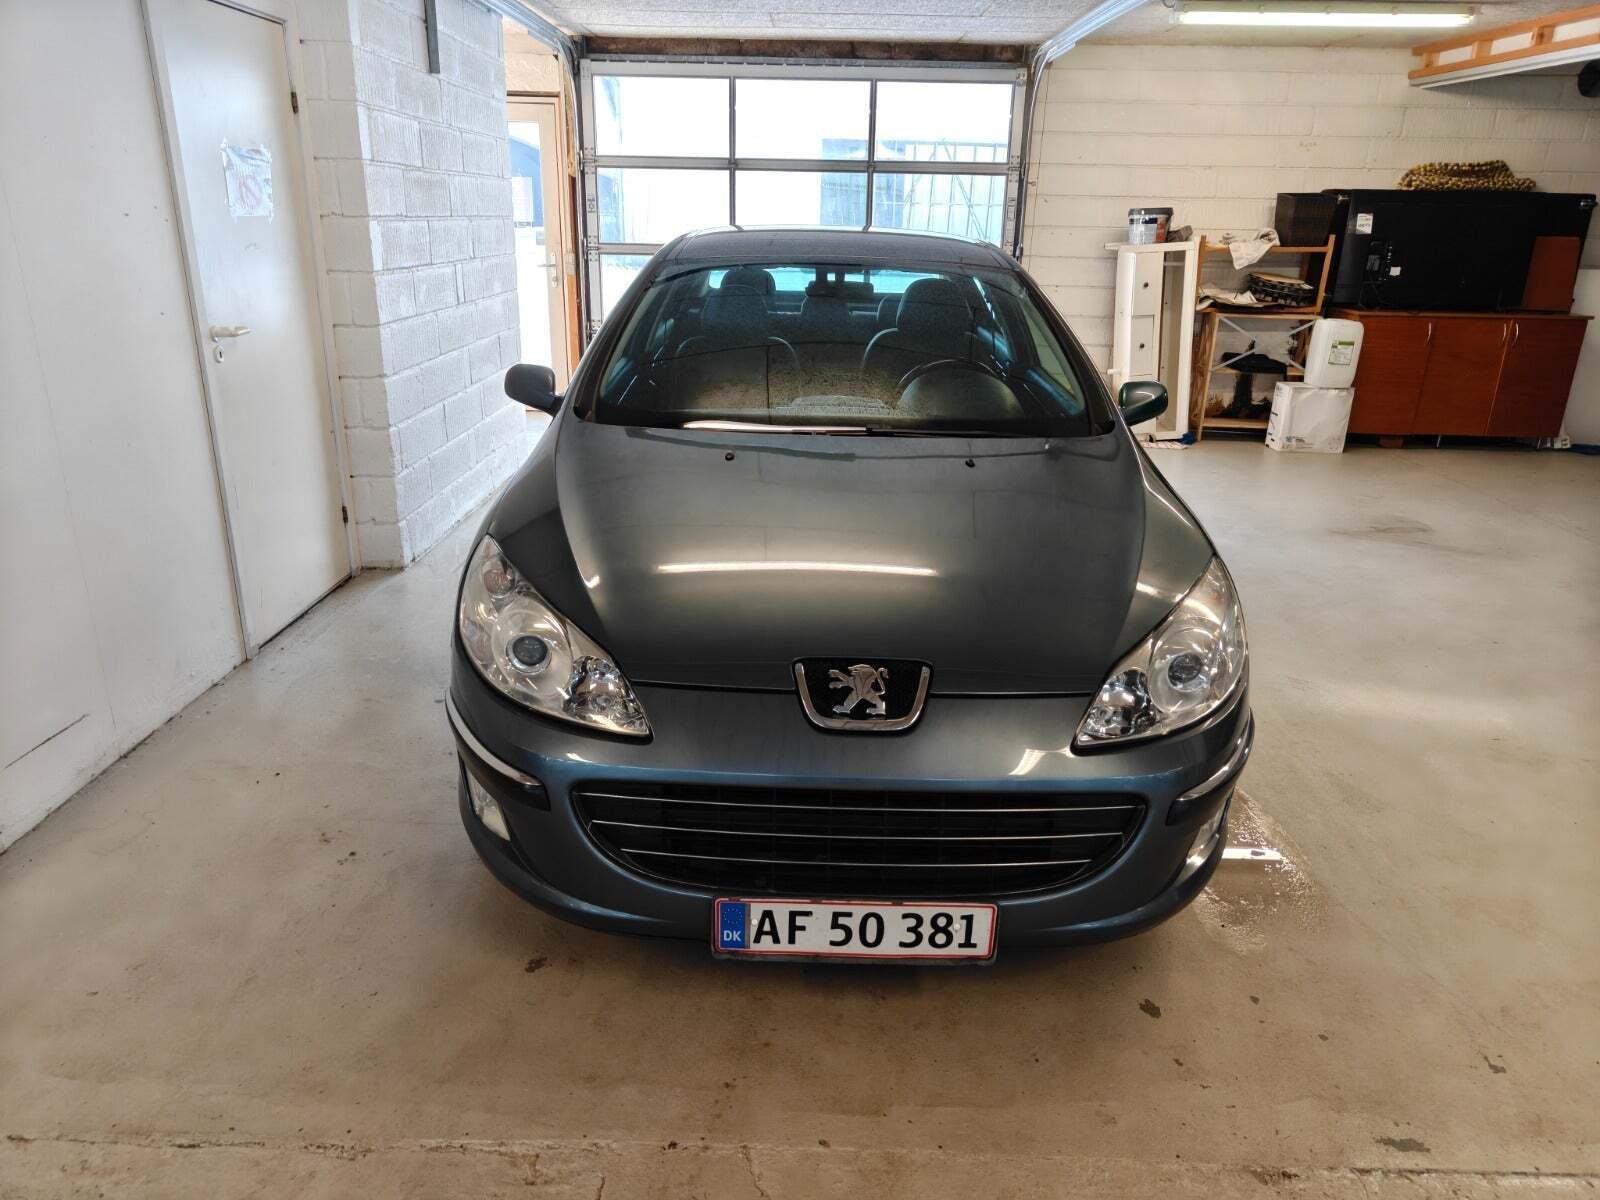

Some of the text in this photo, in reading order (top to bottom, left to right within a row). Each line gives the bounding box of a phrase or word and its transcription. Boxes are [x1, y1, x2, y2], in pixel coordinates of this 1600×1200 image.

[723, 930, 742, 942] DK
[753, 909, 977, 949] AF 50 381
